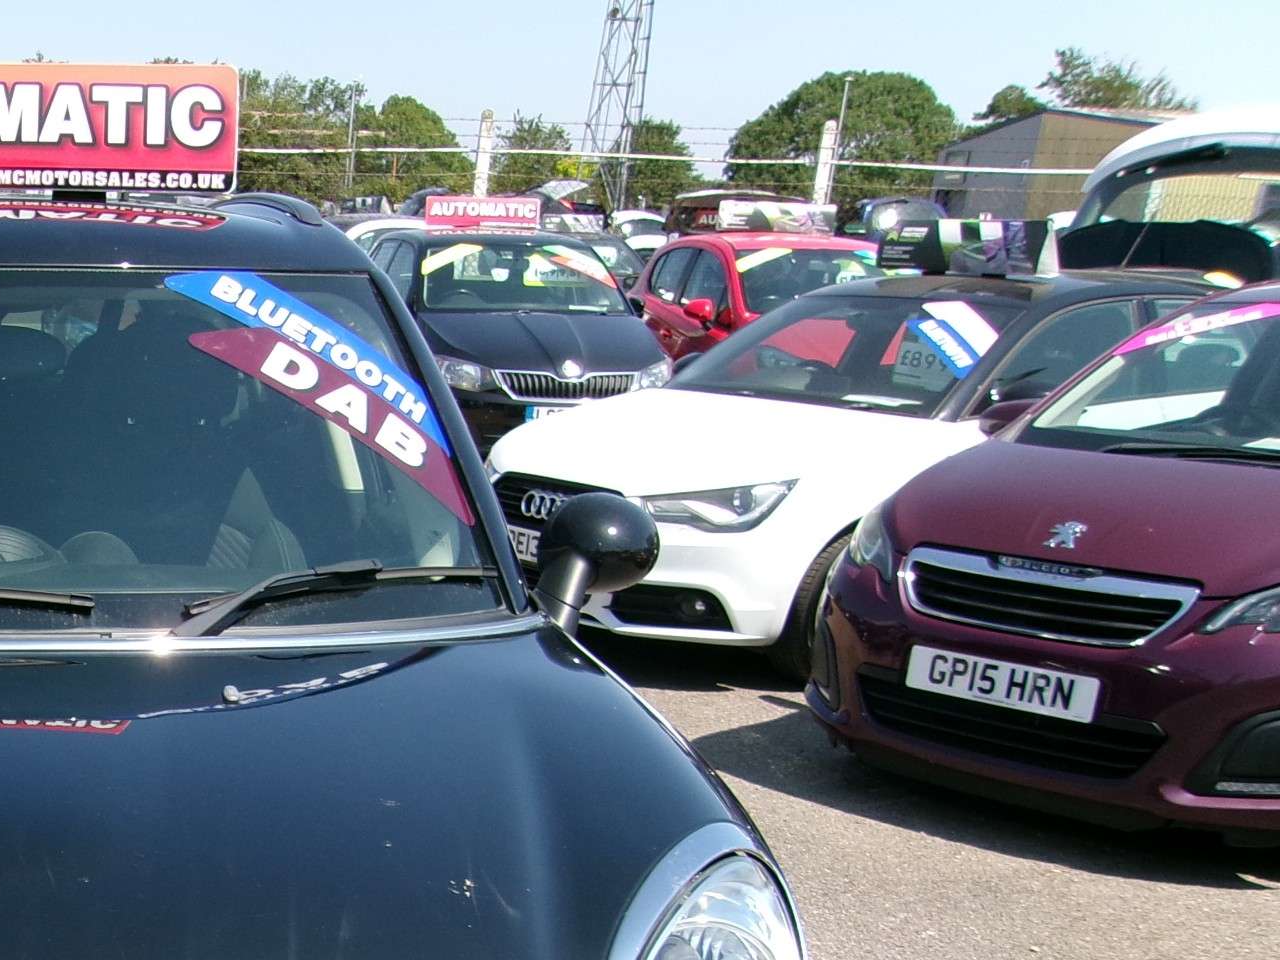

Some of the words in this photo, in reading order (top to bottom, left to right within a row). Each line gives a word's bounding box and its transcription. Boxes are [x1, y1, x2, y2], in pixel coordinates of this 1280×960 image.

[429, 201, 537, 219] AUTOMATIC
[209, 274, 427, 424] BLUETOOTH
[260, 331, 427, 467] DAB
[928, 654, 999, 696] GP15
[1005, 667, 1075, 711] HRN
